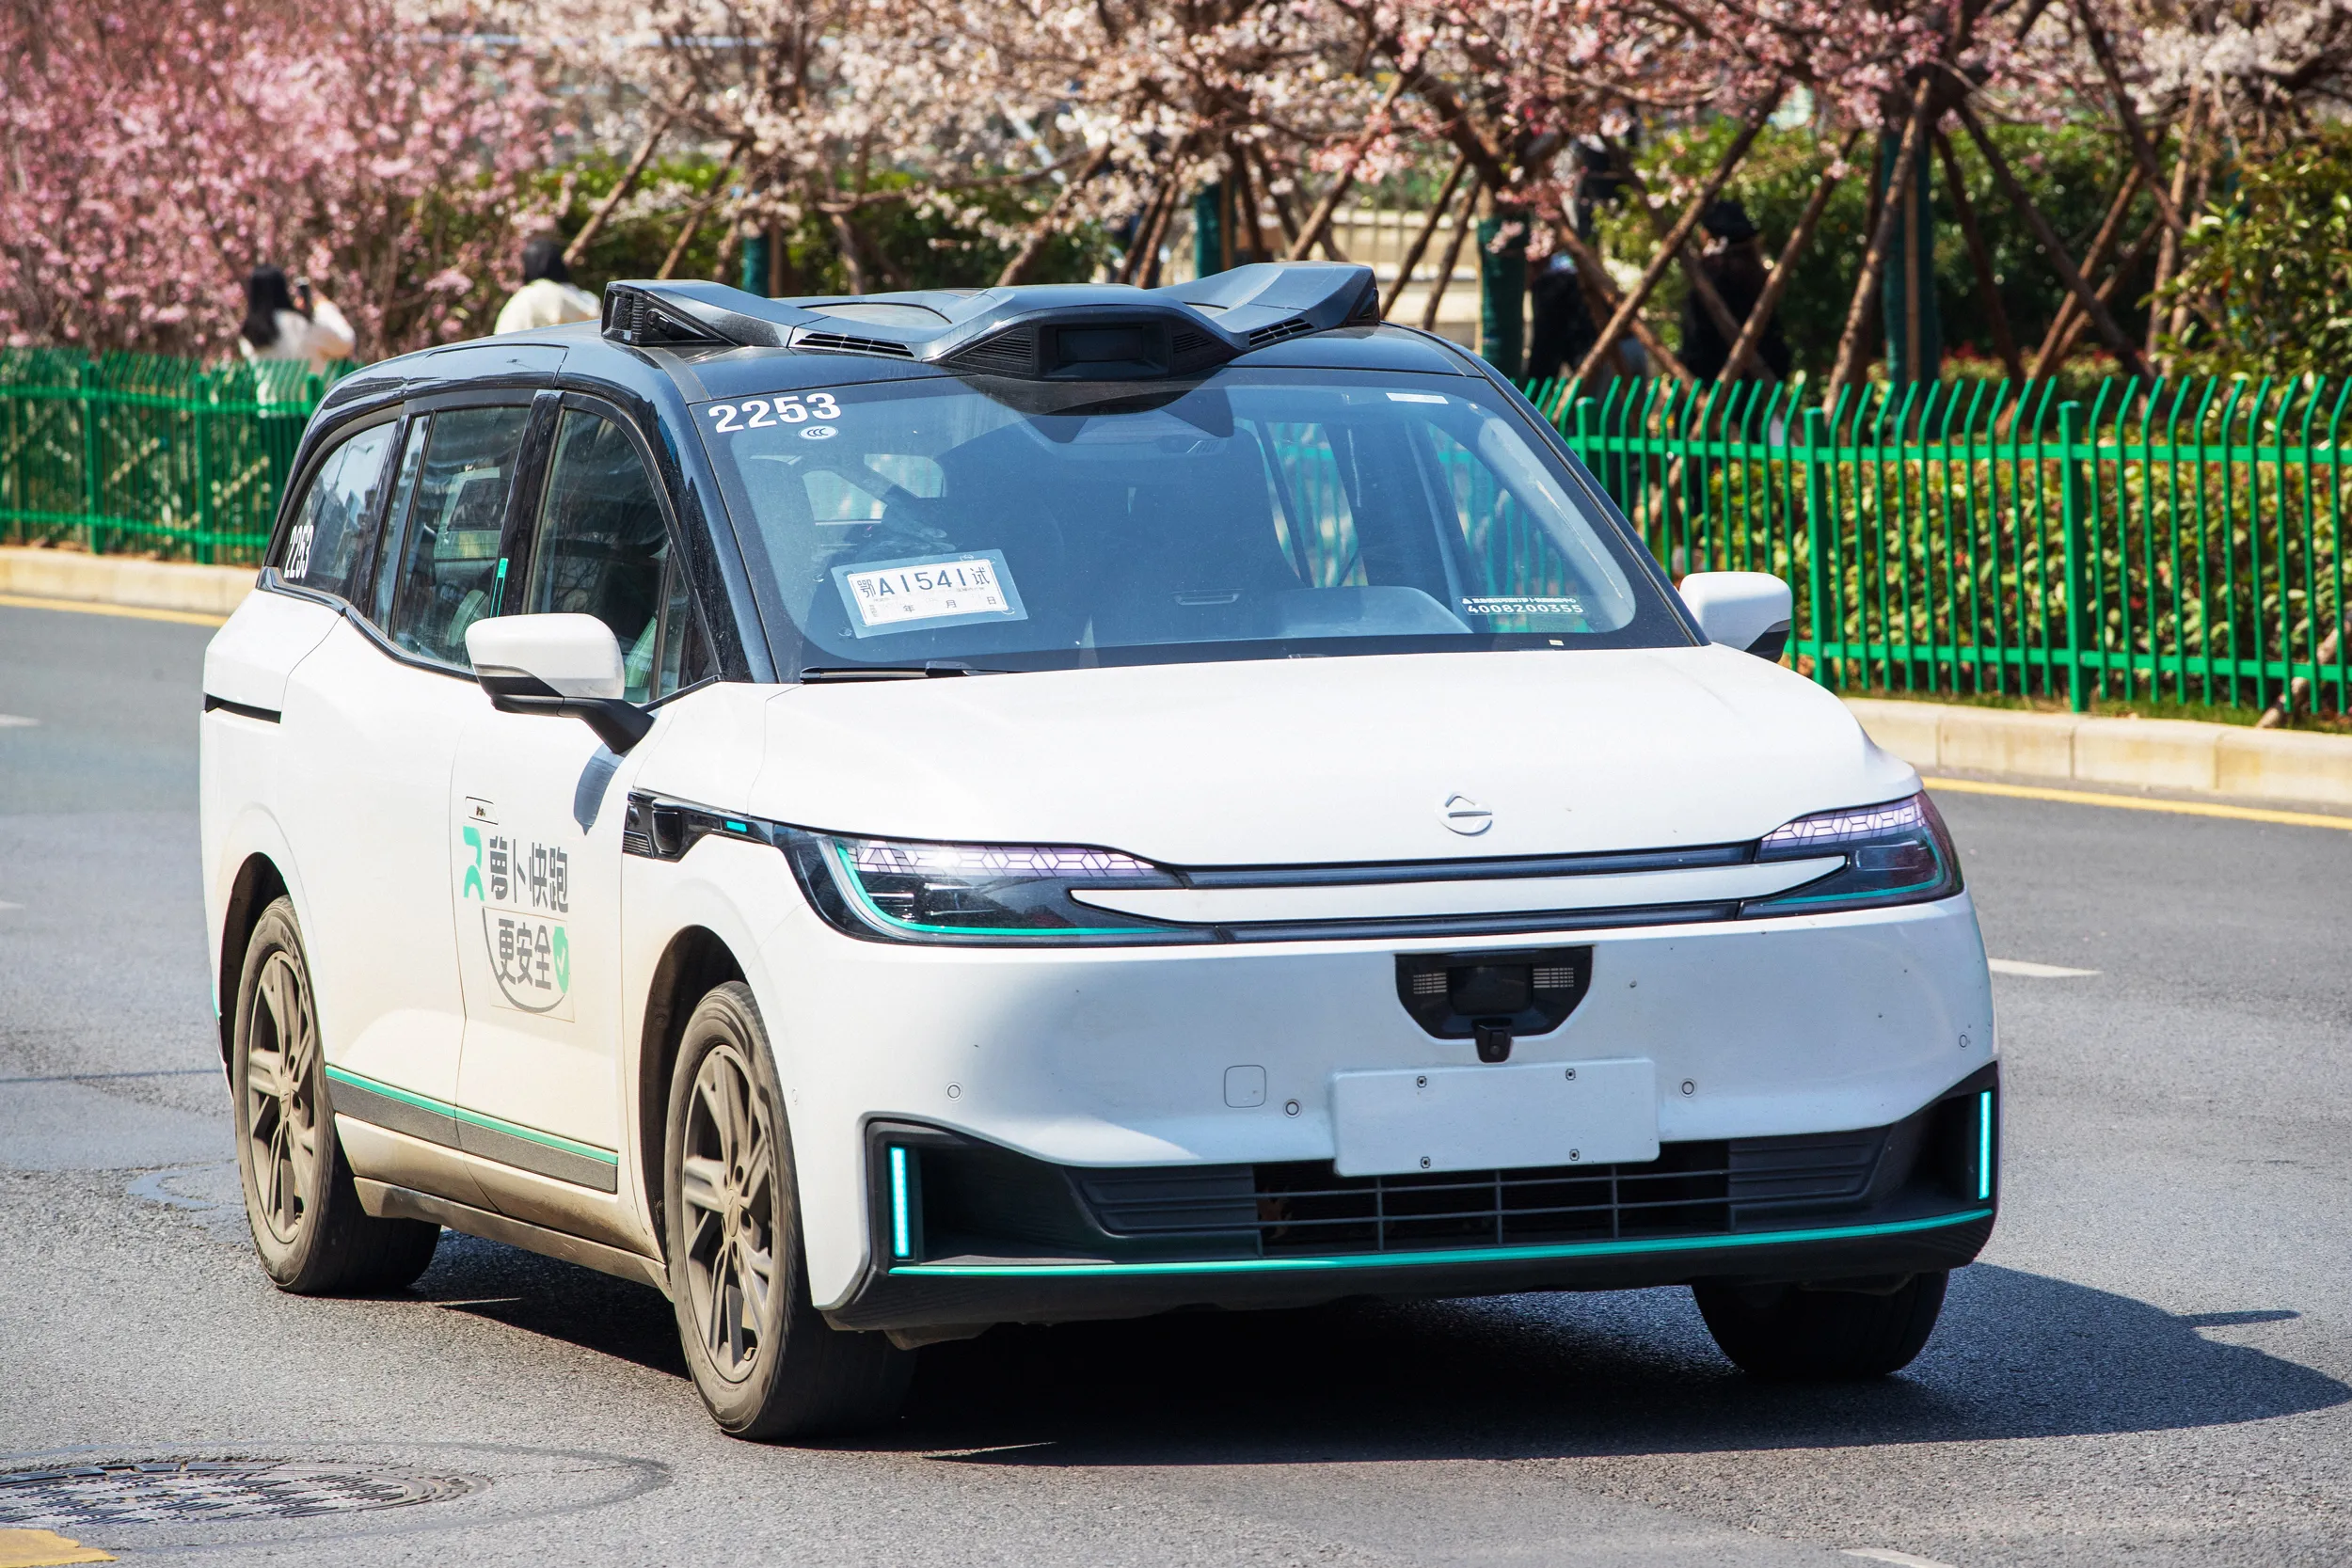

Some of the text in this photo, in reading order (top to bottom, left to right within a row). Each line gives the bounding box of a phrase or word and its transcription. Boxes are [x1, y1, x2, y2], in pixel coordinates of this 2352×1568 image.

[707, 392, 842, 434] 2253
[283, 525, 314, 579] 2253
[902, 596, 997, 613] 年 月 日
[1467, 604, 1584, 613] 4008200355
[489, 835, 569, 913] 萝卜快跑
[498, 918, 552, 990] 更安全
